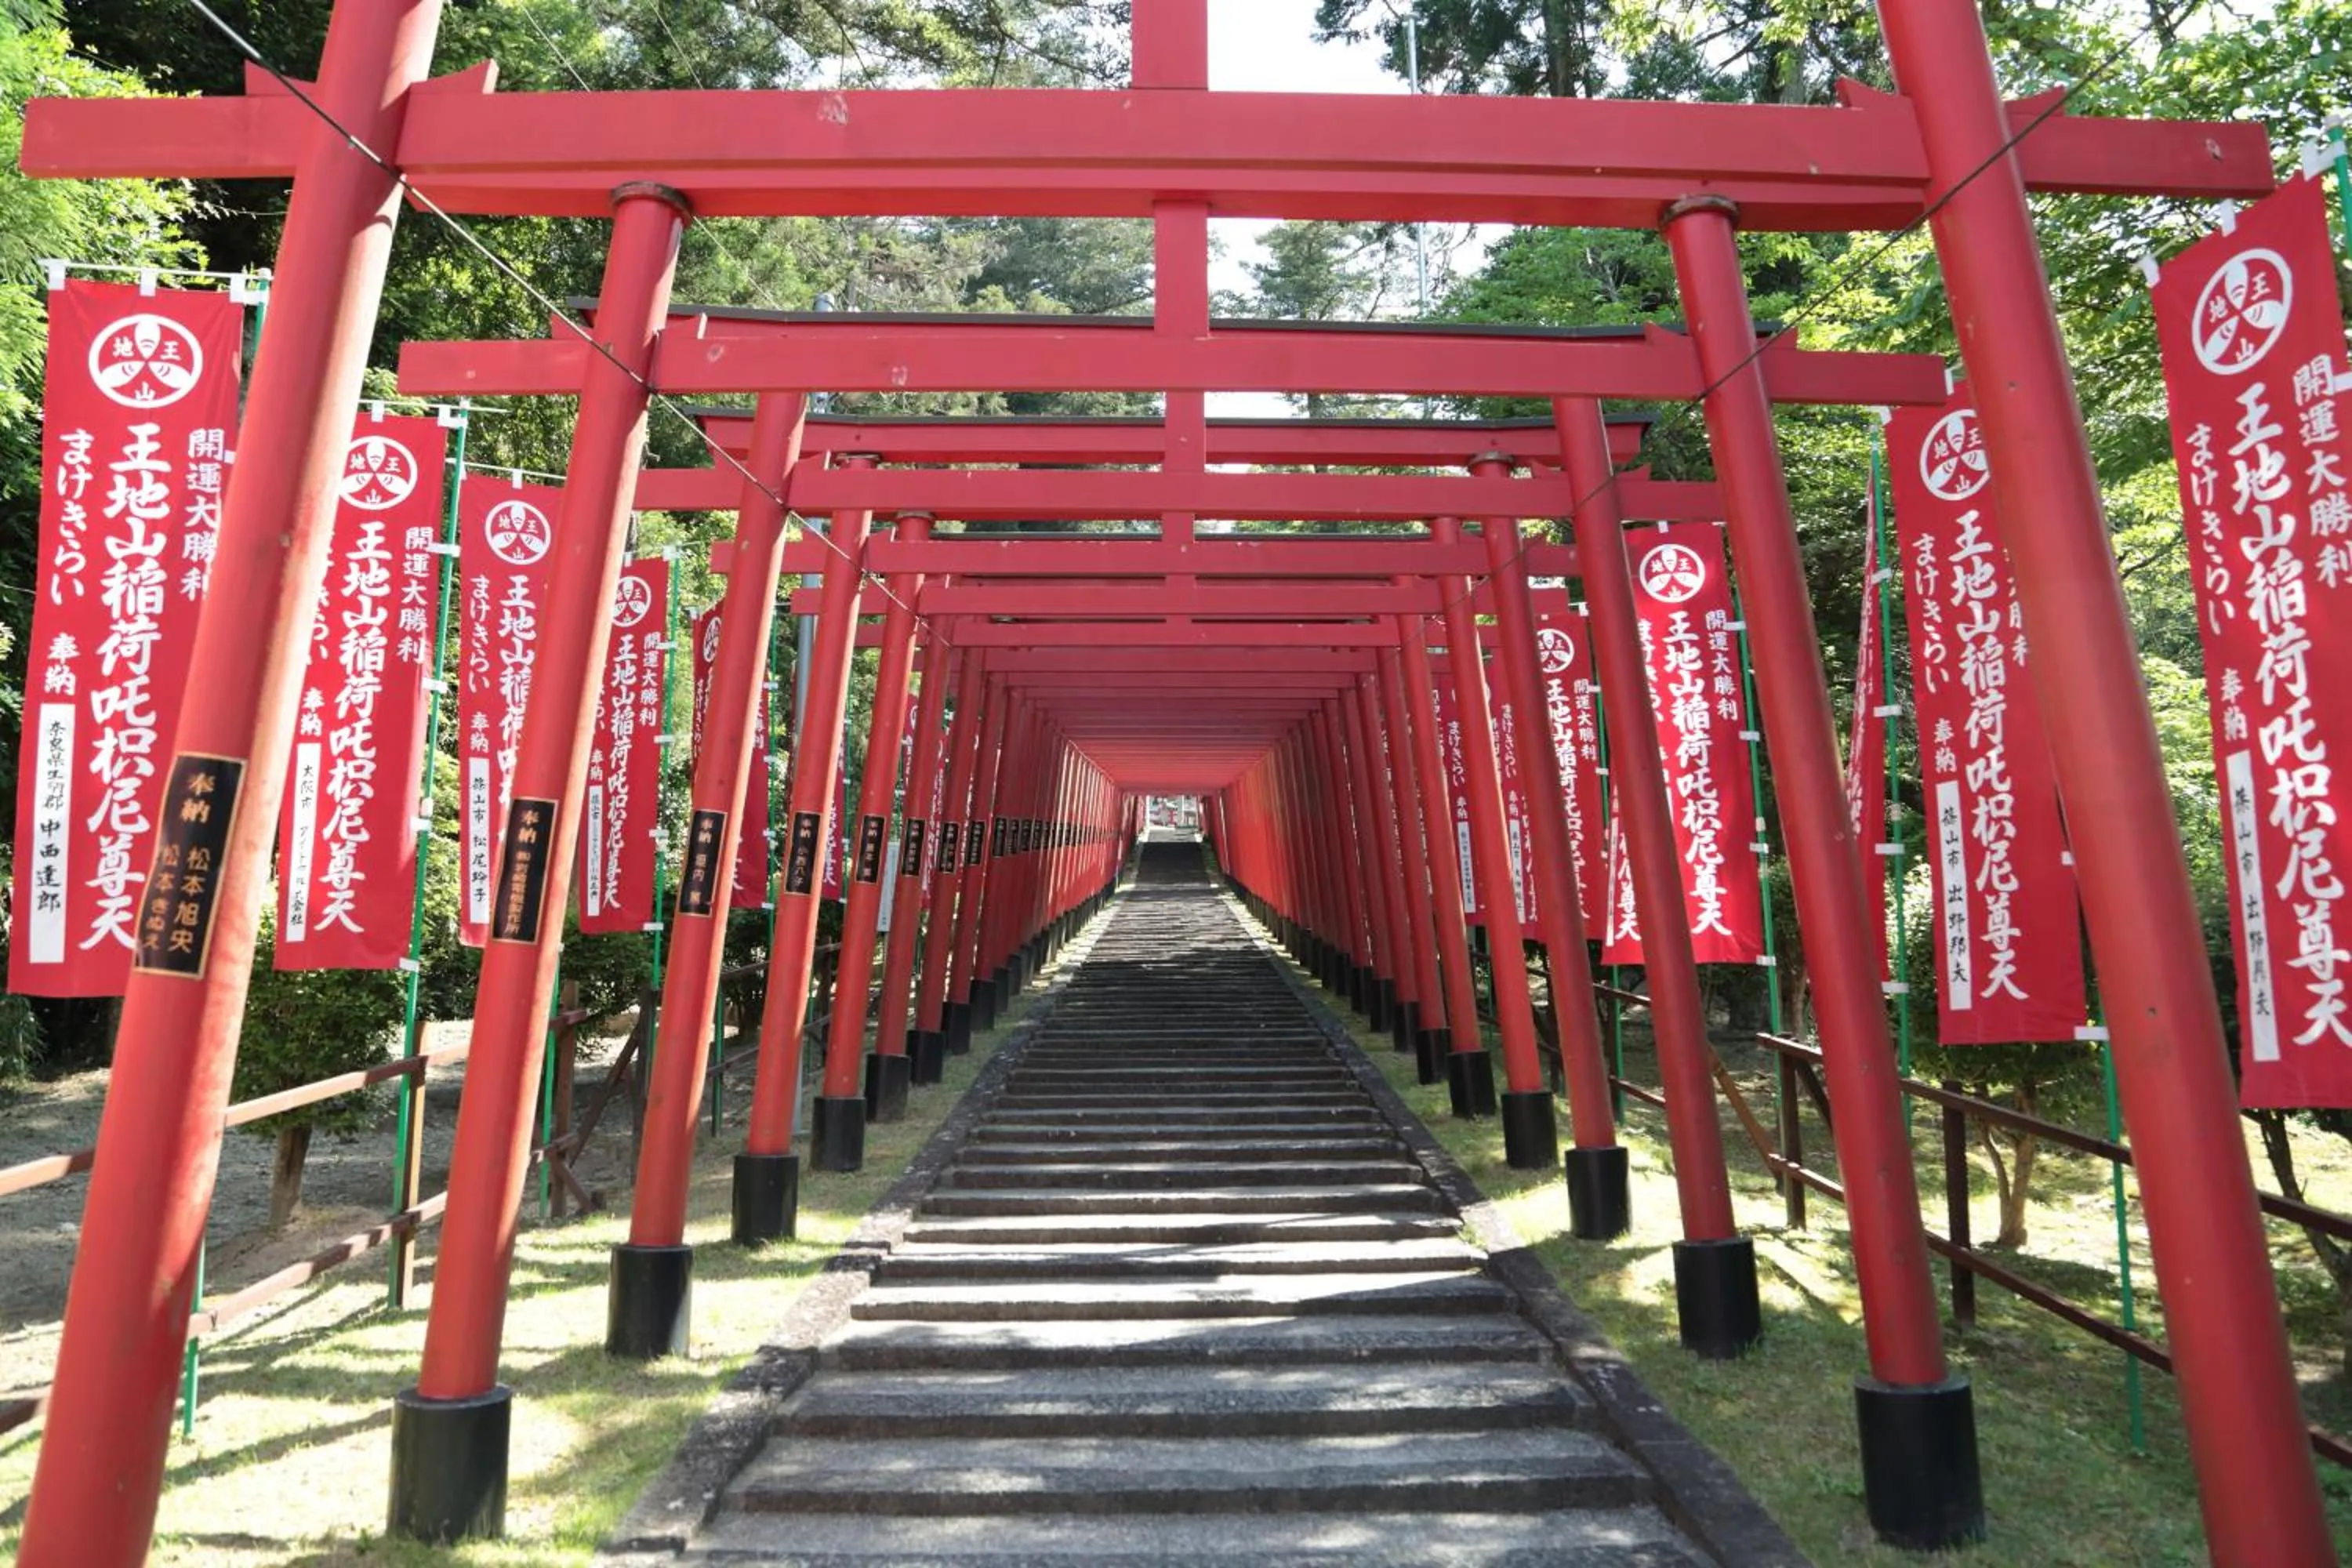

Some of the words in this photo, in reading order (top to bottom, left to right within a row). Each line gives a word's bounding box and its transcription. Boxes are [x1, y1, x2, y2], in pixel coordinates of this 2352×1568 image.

[2208, 295, 2229, 323] 地
[2251, 271, 2272, 301] 王
[113, 337, 135, 358] 地
[161, 340, 181, 361] 王
[2235, 337, 2256, 364] 山
[135, 382, 156, 402] 山
[386, 457, 402, 473] 王
[1965, 427, 1983, 446] 王
[2292, 354, 2352, 588] 開運大勝利
[49, 428, 95, 605] まけきらい
[2186, 423, 2236, 636] まけきらい
[396, 526, 434, 663] 開運大勝利
[1912, 533, 1950, 694] まけきらい
[469, 574, 491, 693] まけきらい
[44, 632, 81, 697] 奉納
[1705, 608, 1738, 720] 開運大勝利
[300, 687, 325, 737] 奉納
[2220, 667, 2249, 742] 奉納
[1933, 717, 1958, 774] 奉納
